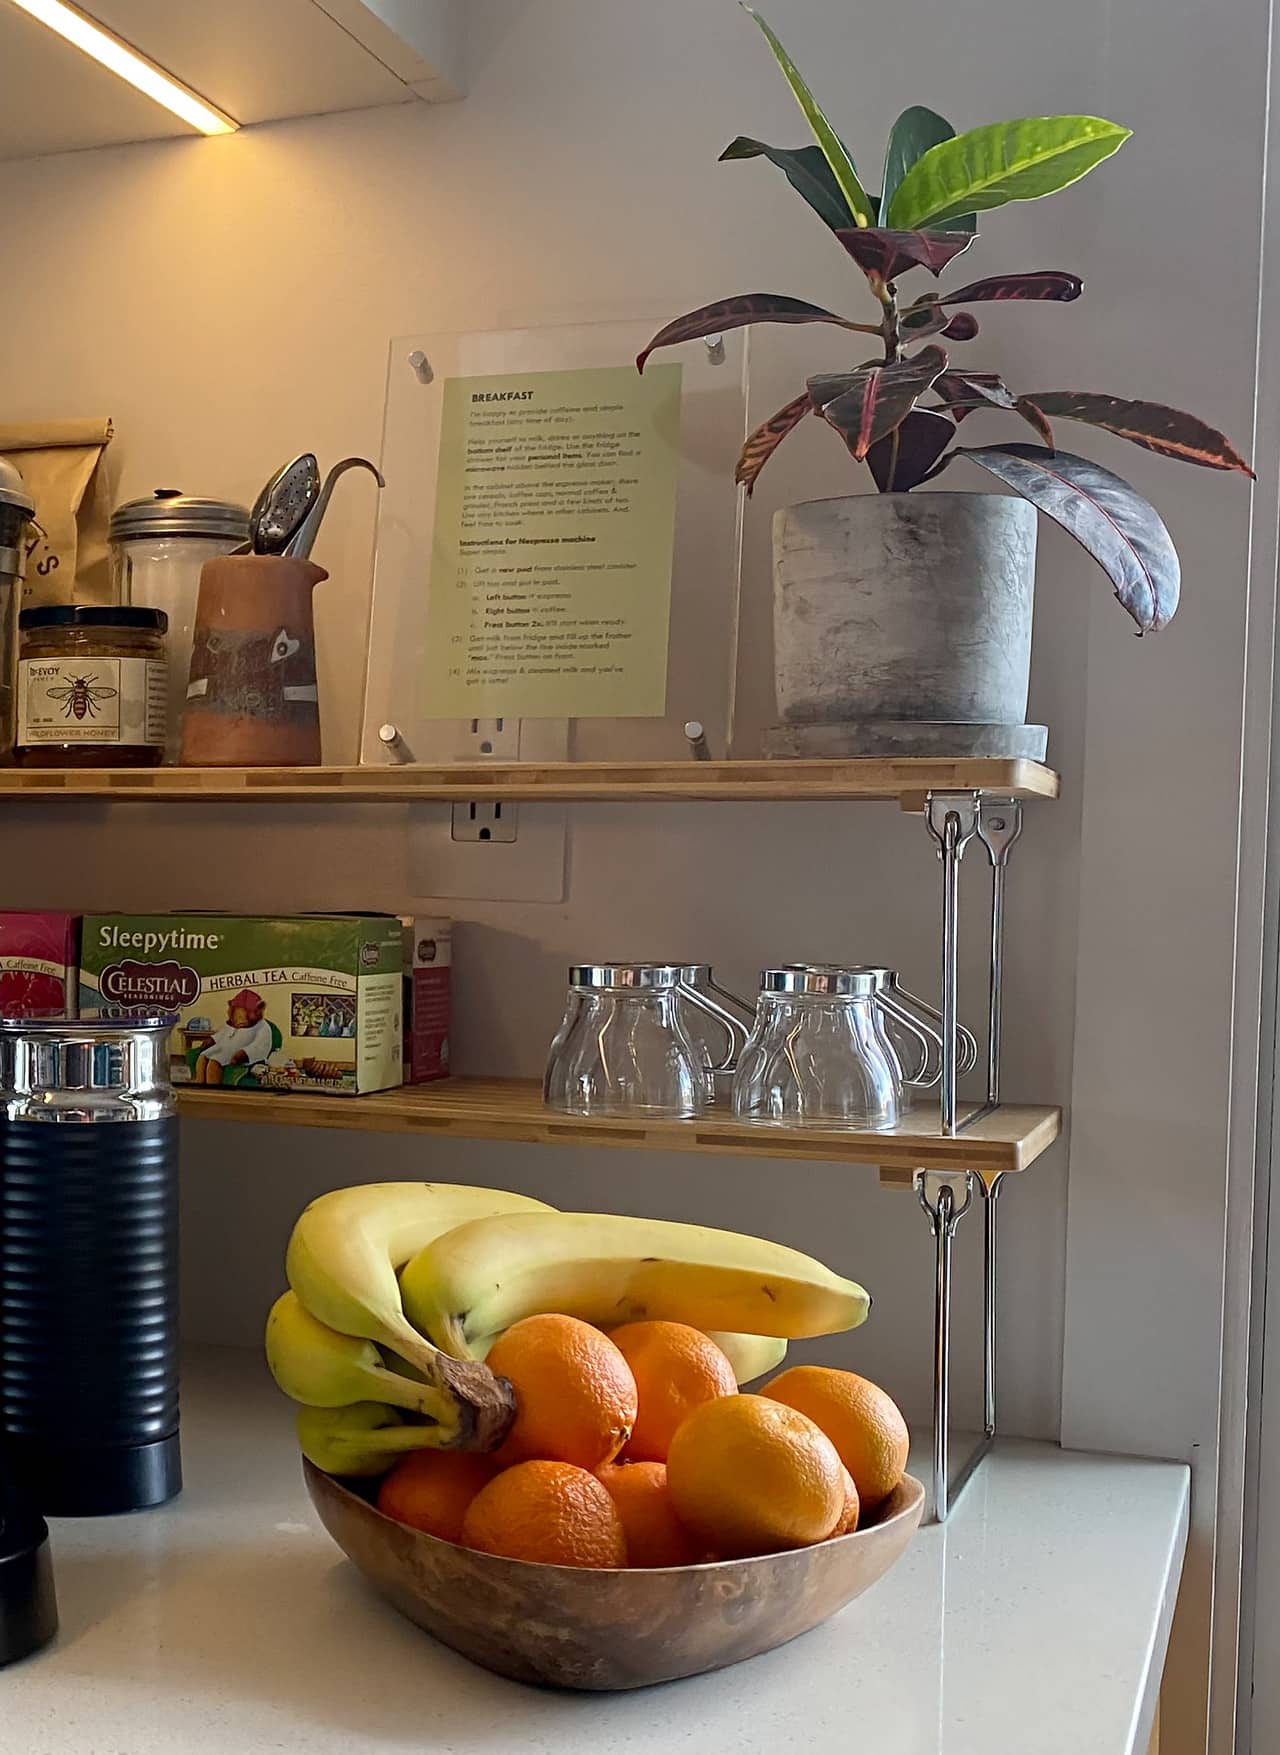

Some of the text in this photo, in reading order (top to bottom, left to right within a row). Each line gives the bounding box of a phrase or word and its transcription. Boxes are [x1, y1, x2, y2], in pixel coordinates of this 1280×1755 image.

[472, 391, 534, 402] BREAKFAST
[561, 535, 596, 543] machine
[516, 565, 532, 573] pod
[506, 606, 530, 614] button
[504, 620, 530, 628] button
[83, 729, 116, 738] HONEY
[99, 926, 219, 954] Sleepytime
[40, 963, 57, 975] Free
[107, 971, 192, 996] CELESTIAL
[210, 970, 348, 990] HERBAL TEA Caffeine Free
[124, 993, 175, 1001] SEASONINGS
